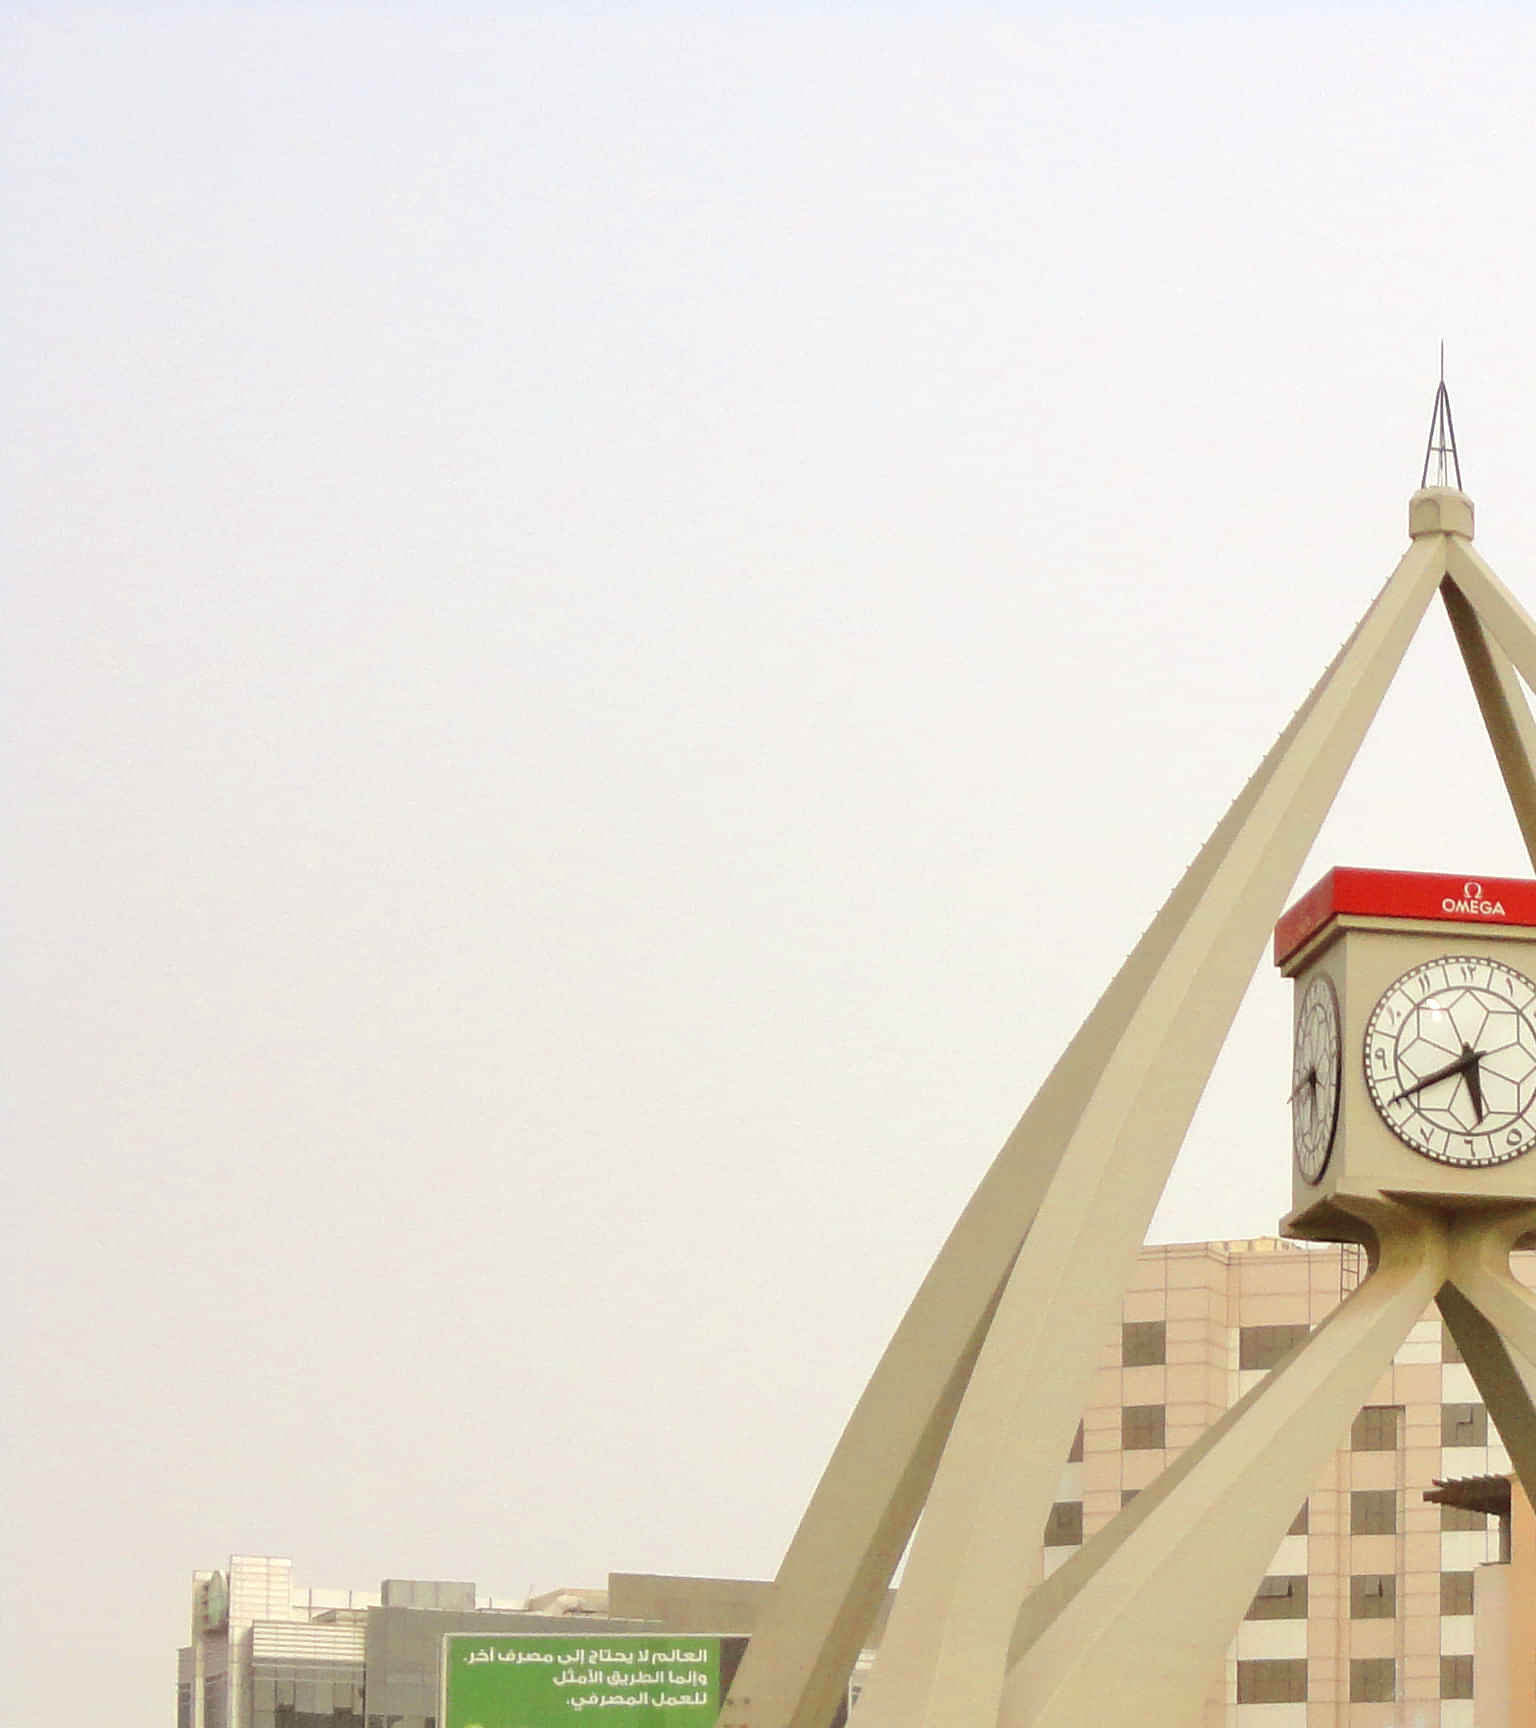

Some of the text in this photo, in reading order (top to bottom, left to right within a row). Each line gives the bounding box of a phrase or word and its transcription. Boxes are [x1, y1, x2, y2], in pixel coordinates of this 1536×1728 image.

[1442, 897, 1506, 917] OMEGA
[1460, 965, 1477, 982] ١٢
[498, 1649, 553, 1665] مصرف
[588, 1649, 634, 1665] يحتاج
[637, 1649, 649, 1663] لا
[651, 1649, 708, 1665] العالم
[607, 1670, 665, 1686] الطريق
[651, 1692, 708, 1706] للعمل
